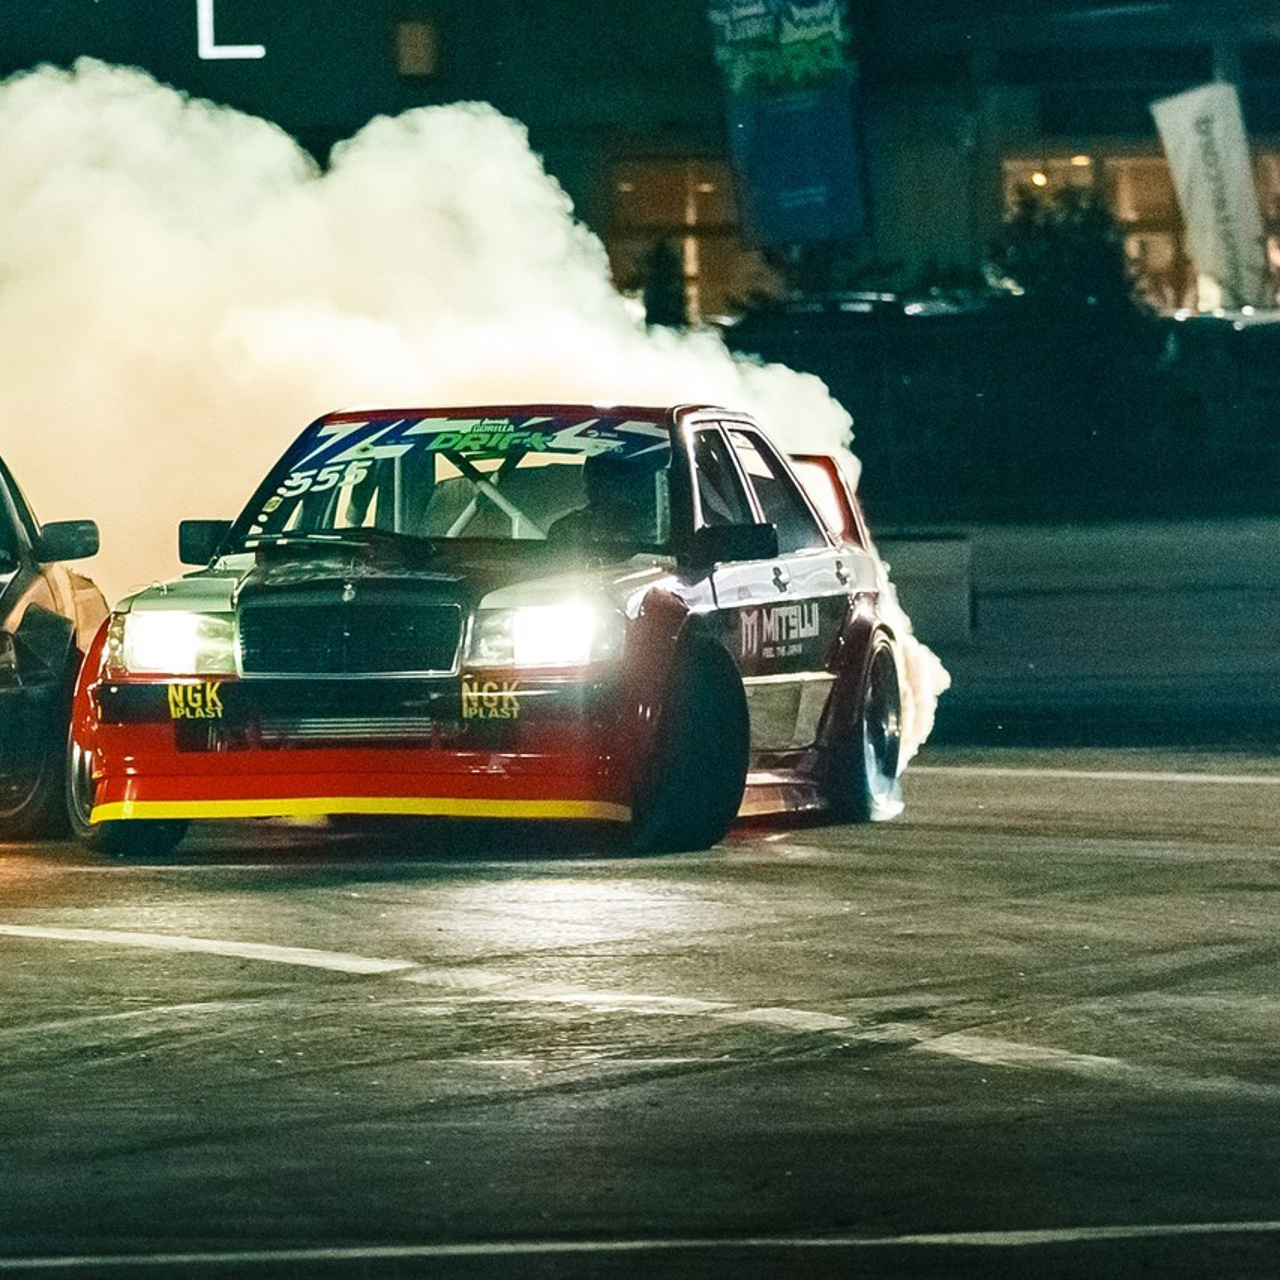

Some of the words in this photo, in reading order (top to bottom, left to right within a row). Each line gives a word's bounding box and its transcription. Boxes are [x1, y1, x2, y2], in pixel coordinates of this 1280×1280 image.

[168, 682, 223, 718] NGK
[462, 681, 519, 718] NGK
[176, 707, 223, 718] PLAST
[468, 707, 519, 718] PLAST
